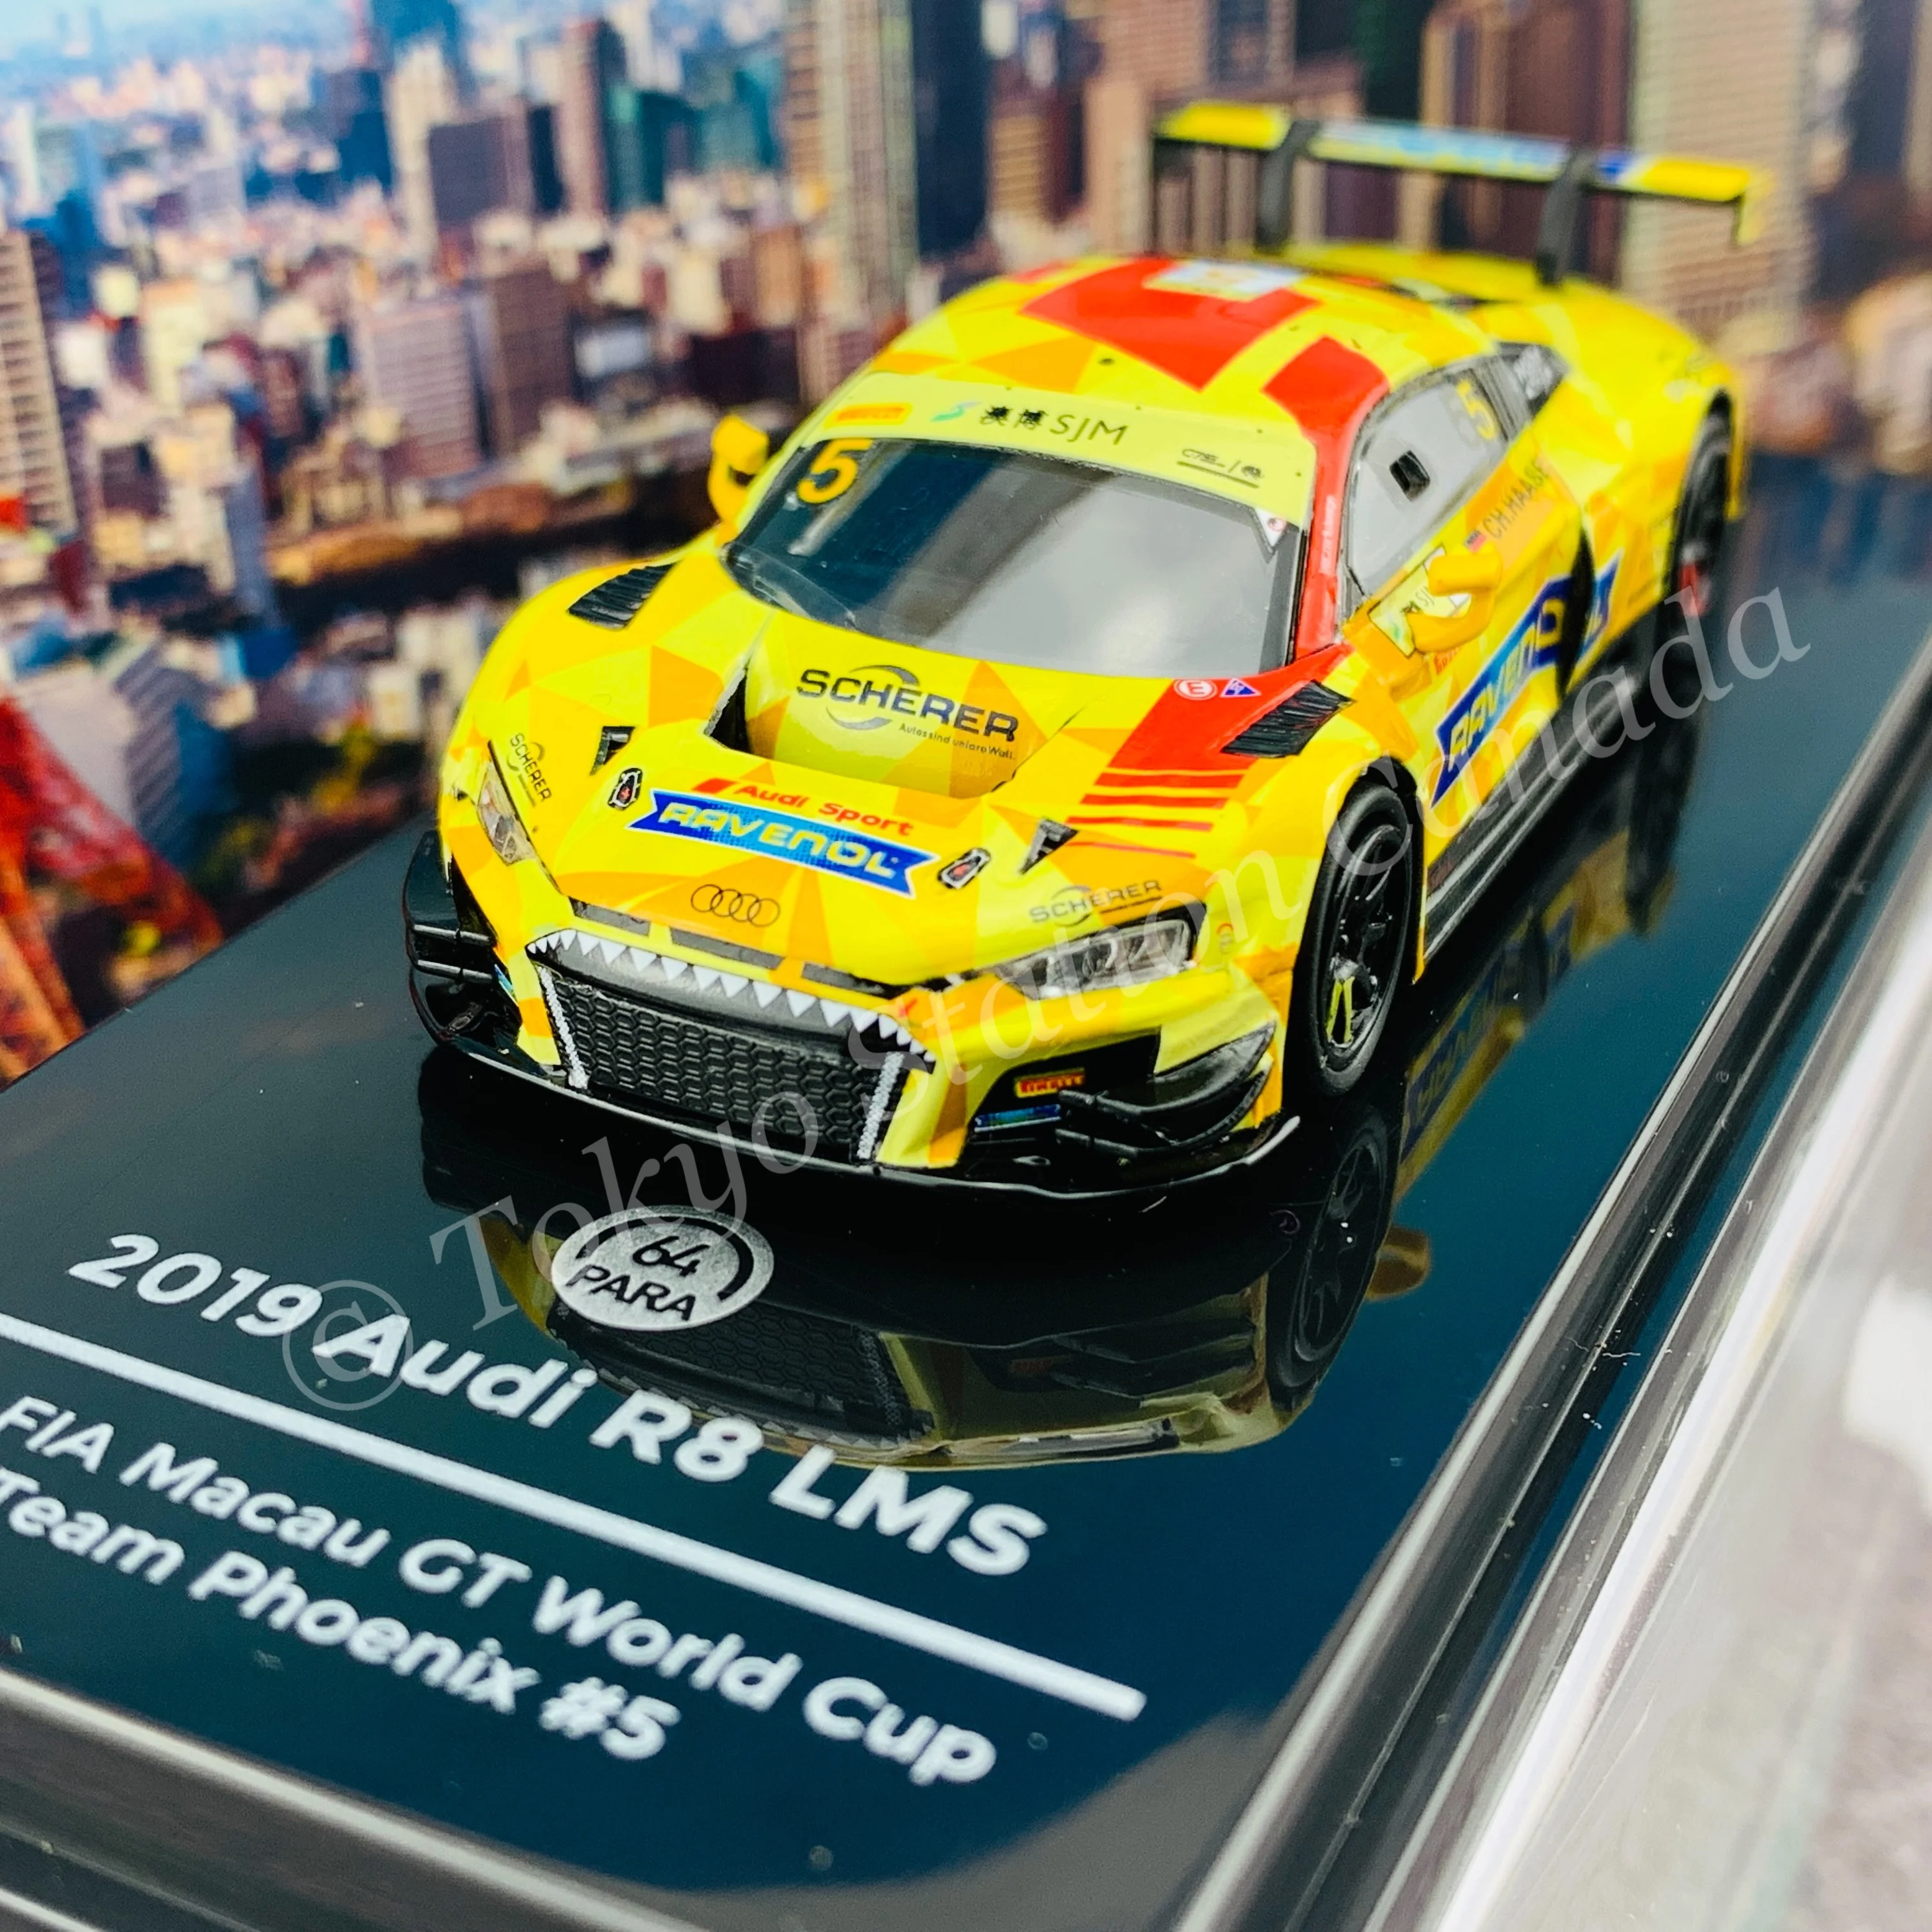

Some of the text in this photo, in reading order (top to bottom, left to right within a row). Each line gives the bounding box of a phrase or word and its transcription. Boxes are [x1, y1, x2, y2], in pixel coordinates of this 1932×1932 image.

[1050, 414, 1128, 445] SJM
[1457, 379, 1496, 440] 5
[797, 438, 873, 504] 5
[796, 668, 1019, 742] SCHERER
[510, 733, 552, 802] SCHERER
[659, 802, 896, 880] RAVENOL
[734, 786, 914, 837] Audi Sport
[1029, 880, 1162, 923] SCHERER
[632, 1235, 710, 1276] 64
[566, 1264, 697, 1321] PARA
[67, 1234, 1047, 1576] 2019 Audi R8 LMS
[0, 1396, 997, 1785] FIA Macau GT World Cup
[0, 1467, 681, 1760] Team Phoenix #5
